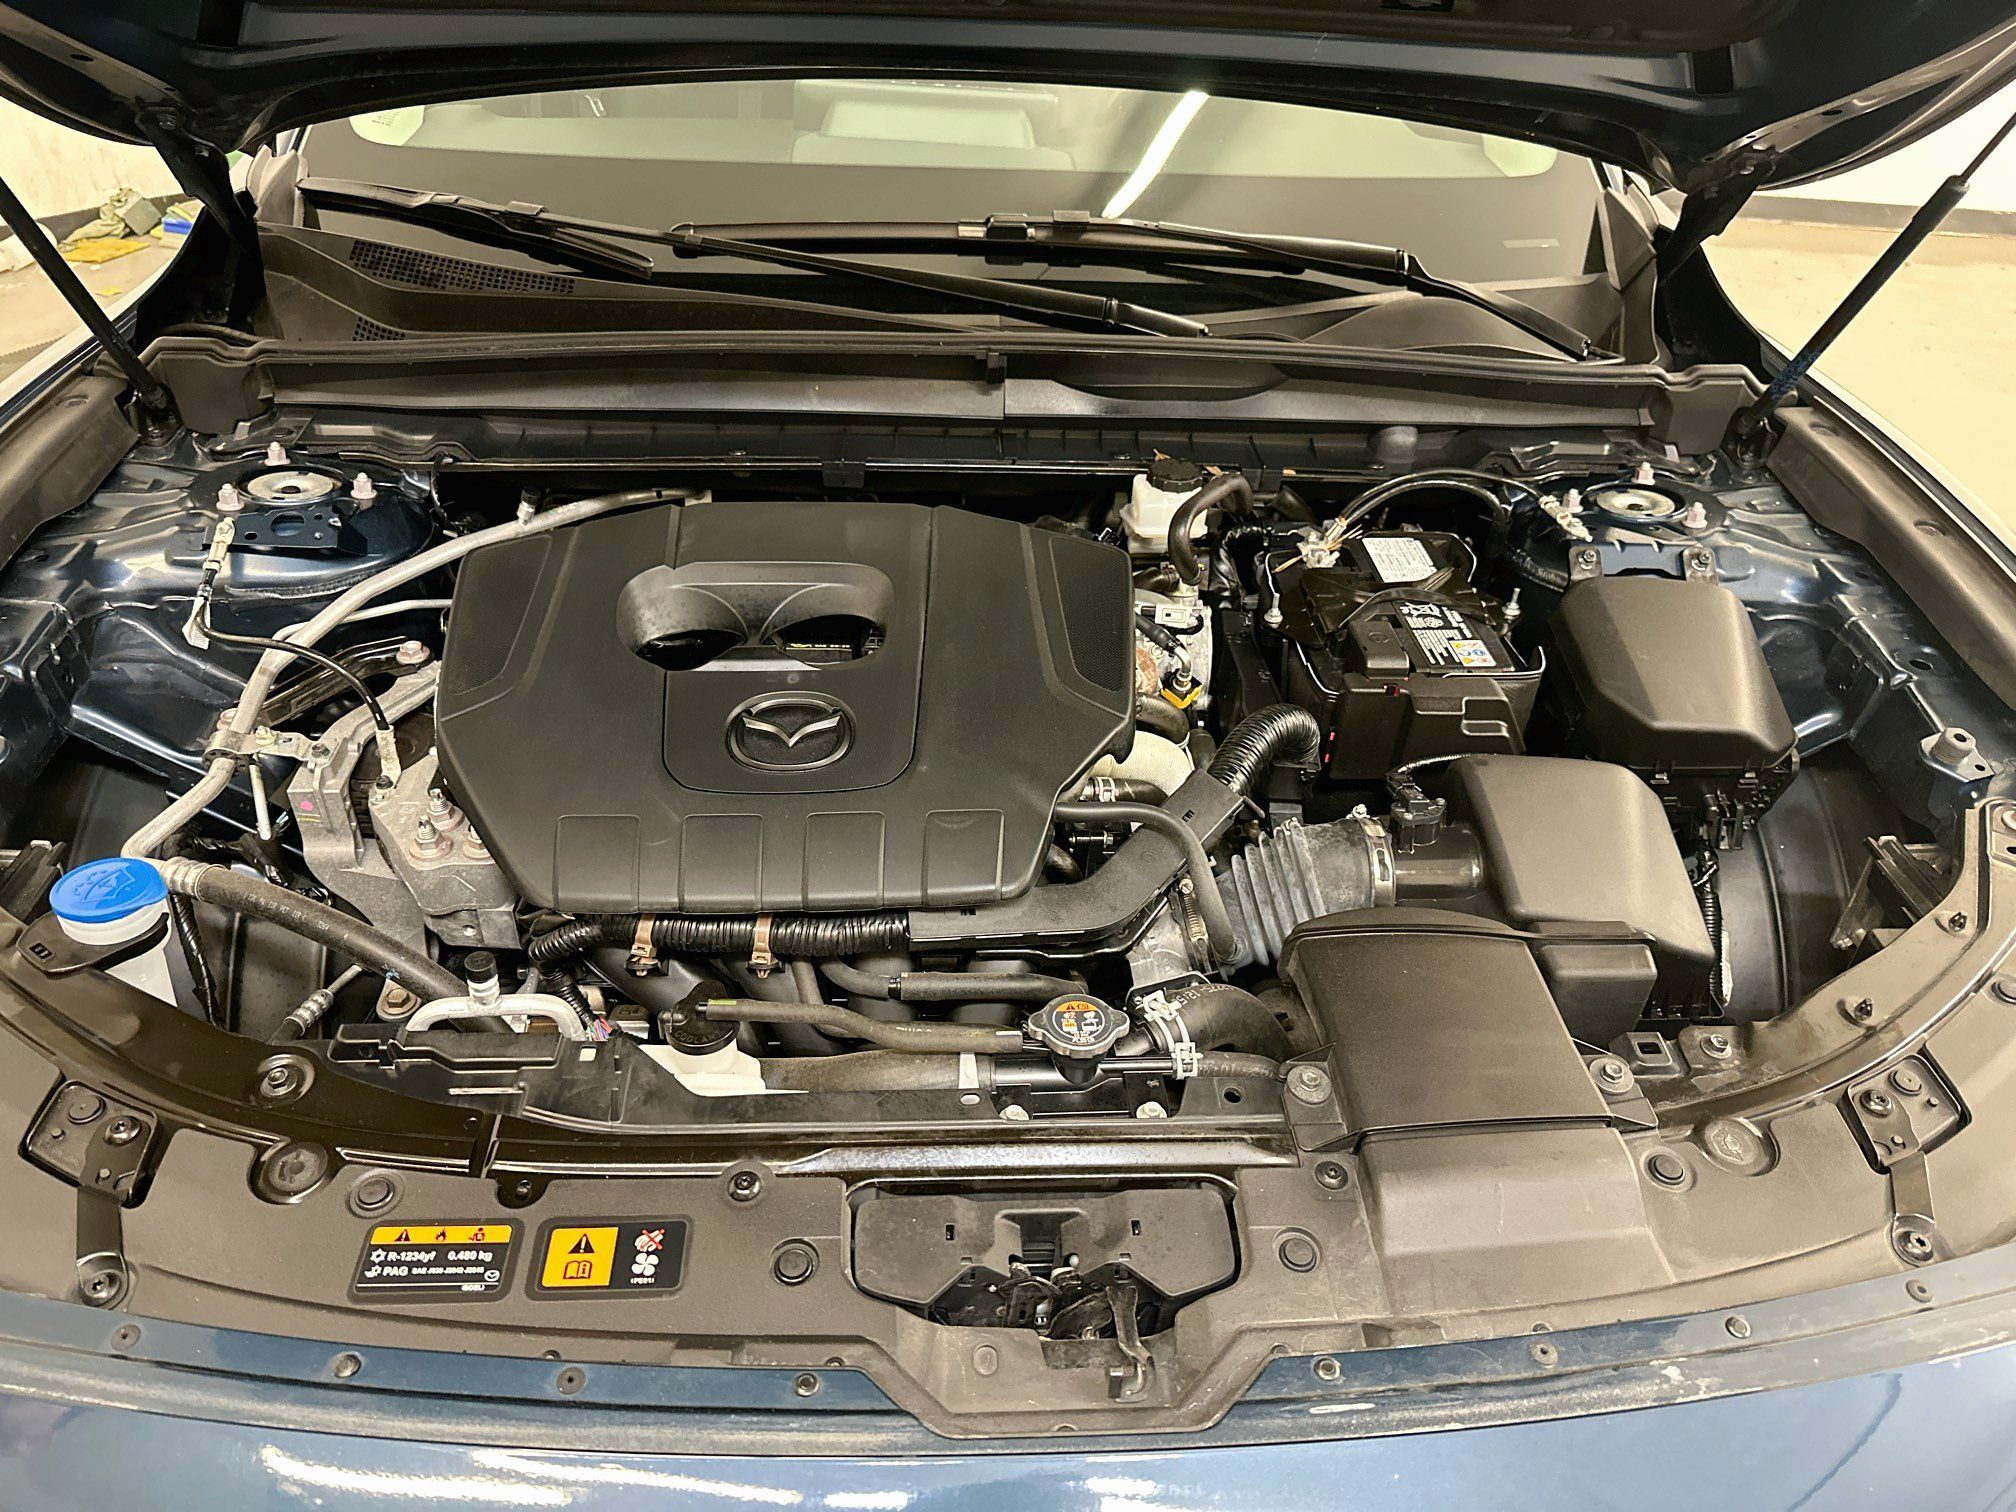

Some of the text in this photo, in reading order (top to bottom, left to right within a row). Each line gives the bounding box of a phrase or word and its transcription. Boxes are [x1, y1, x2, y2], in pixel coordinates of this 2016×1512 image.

[386, 1250, 437, 1264] R-1234yf
[478, 1250, 494, 1263] kg
[382, 1265, 409, 1277] PAG
